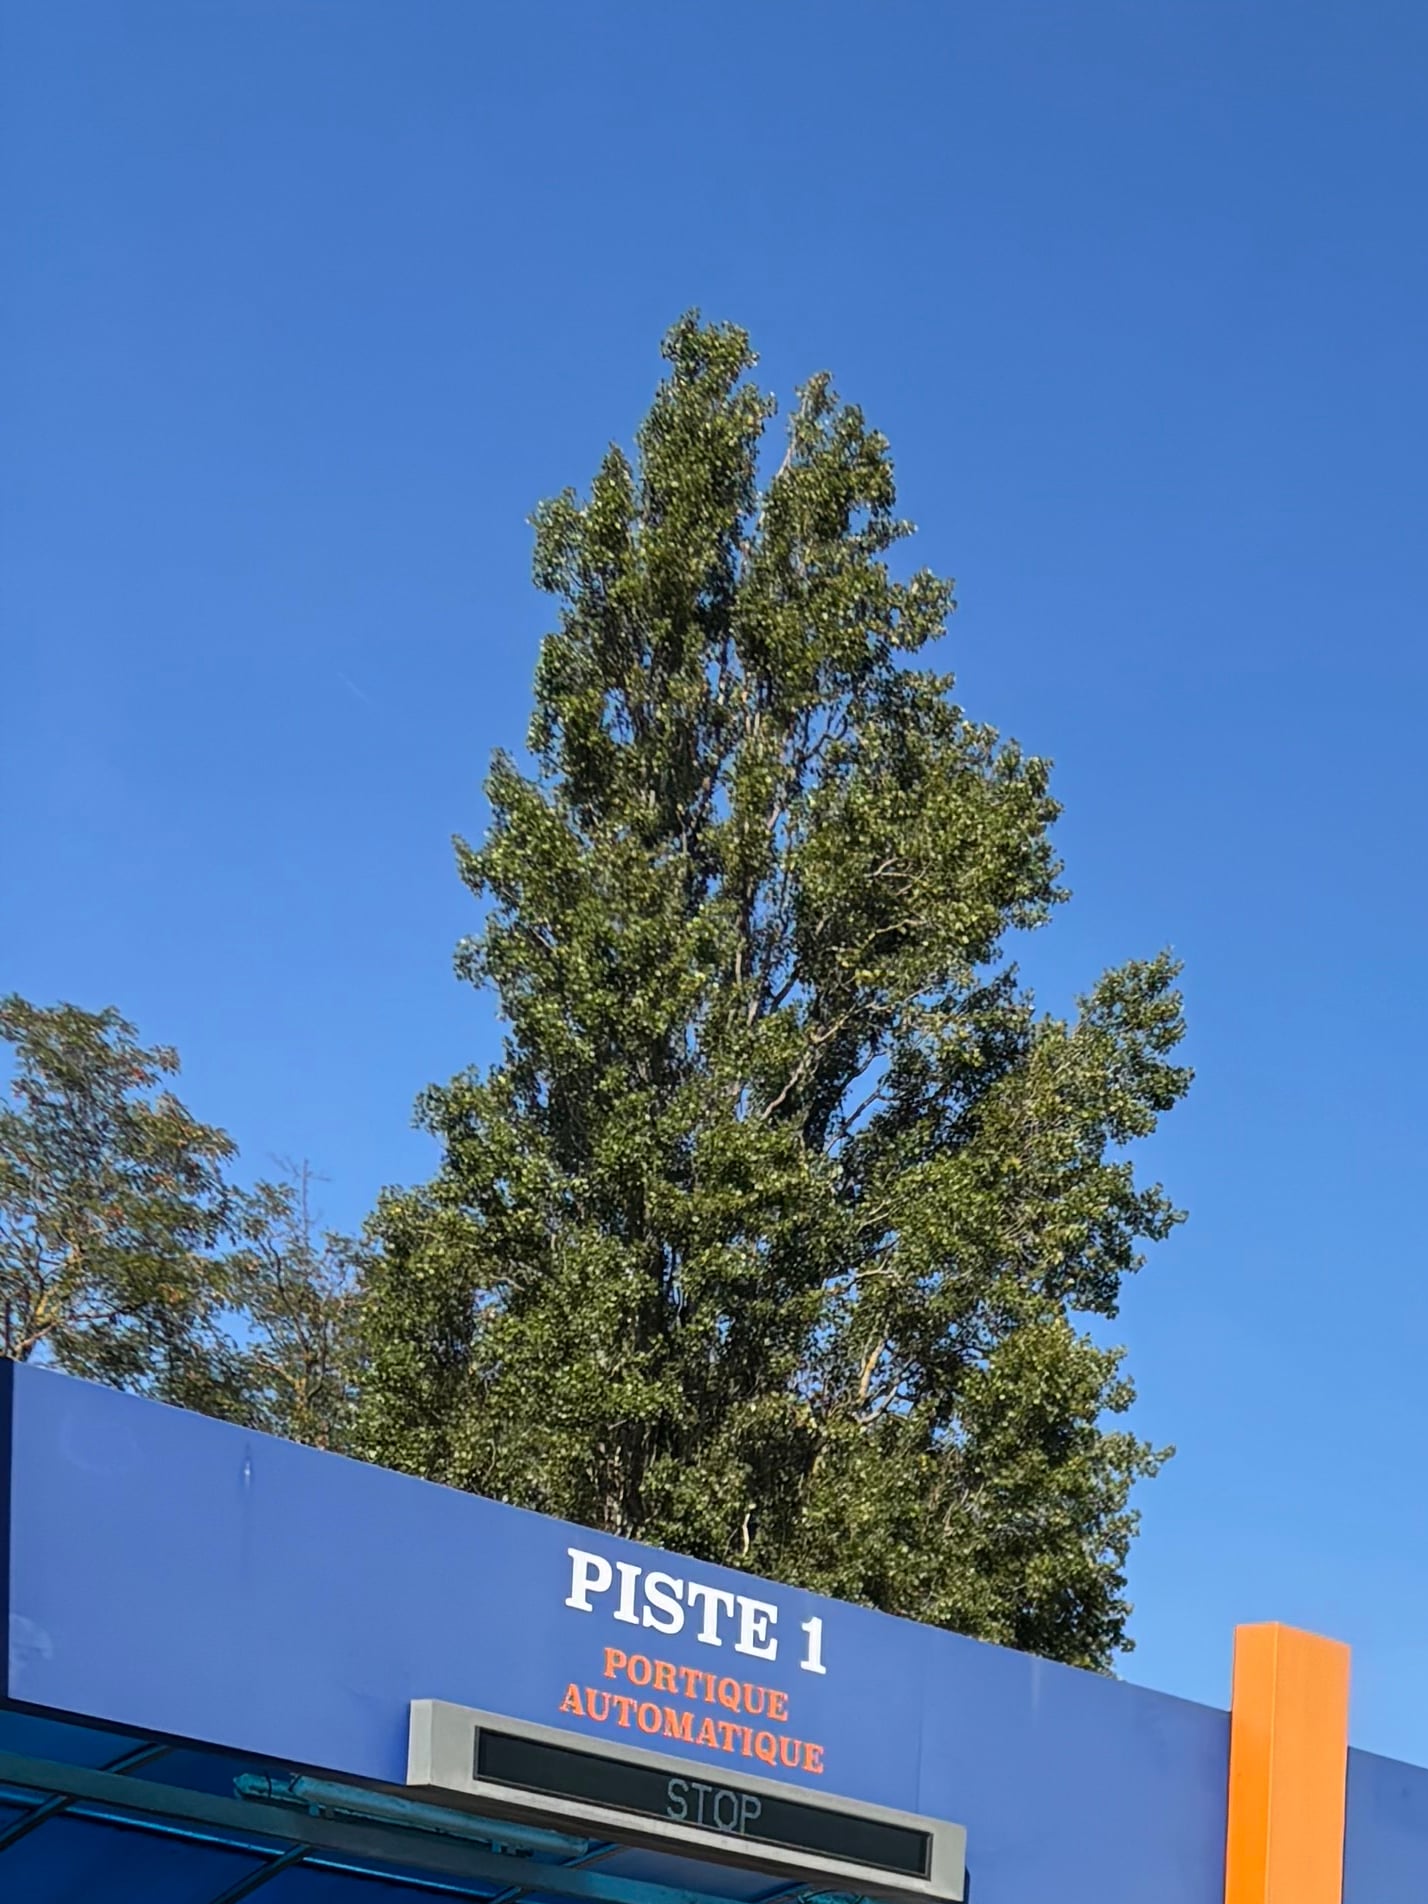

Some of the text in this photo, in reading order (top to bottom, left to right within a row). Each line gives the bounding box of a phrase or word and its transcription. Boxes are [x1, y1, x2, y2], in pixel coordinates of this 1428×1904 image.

[565, 1547, 827, 1675] PISTE 1
[602, 1647, 789, 1722] PORTIQUE
[560, 1683, 825, 1774] AUTOMATIQUE
[666, 1778, 762, 1836] STOP
